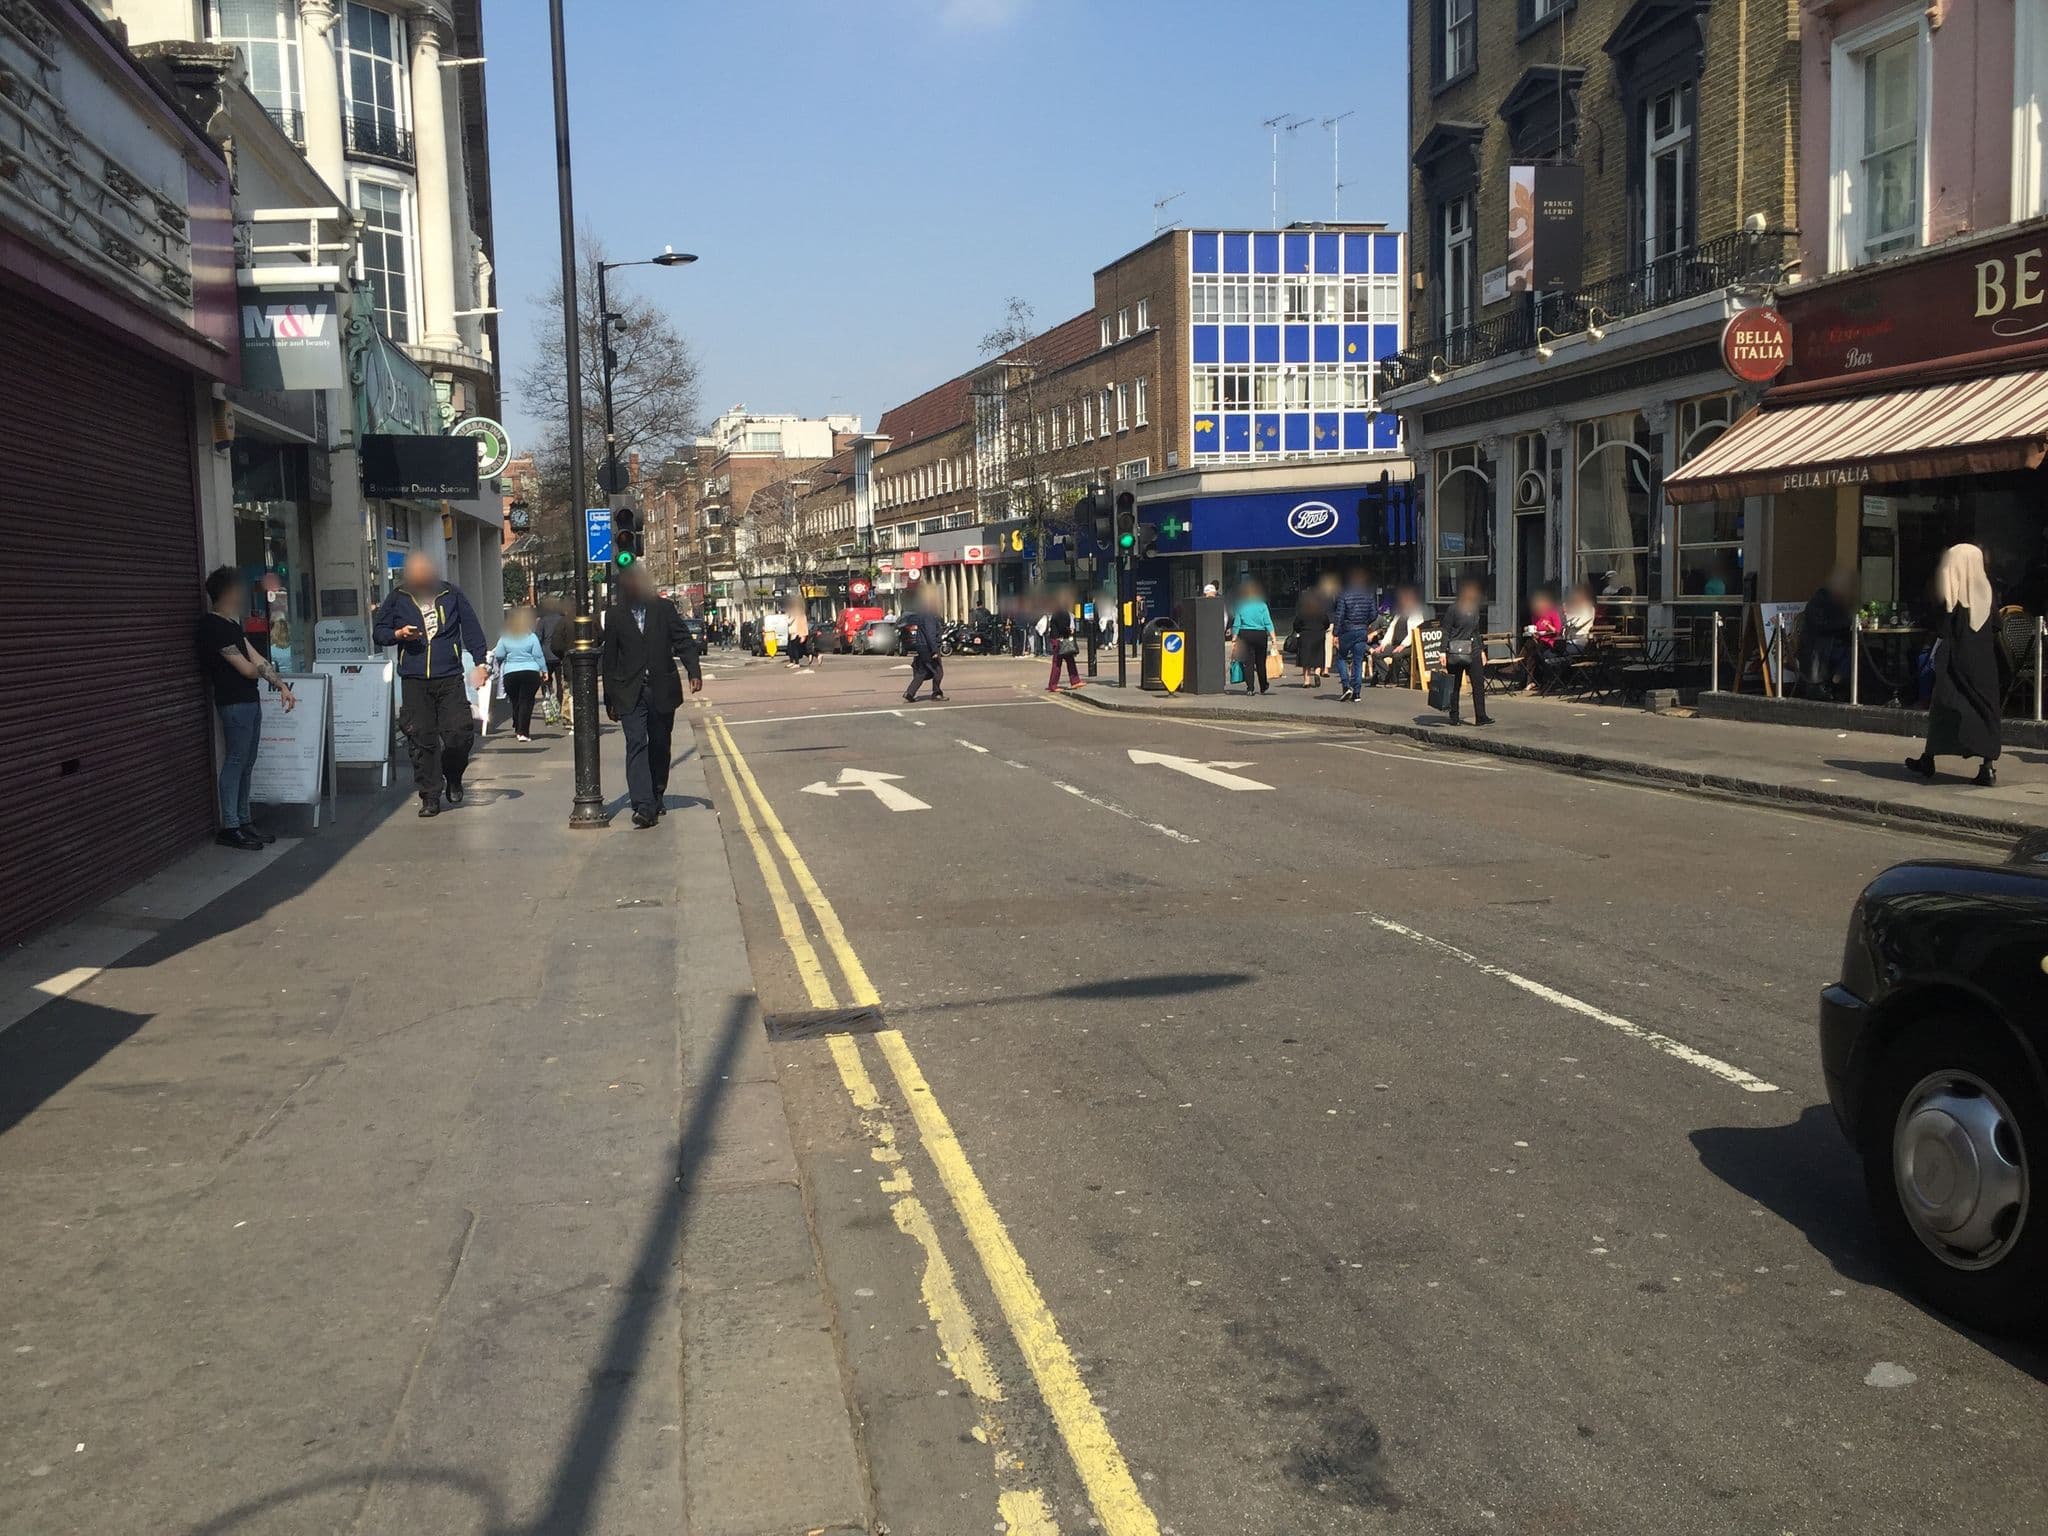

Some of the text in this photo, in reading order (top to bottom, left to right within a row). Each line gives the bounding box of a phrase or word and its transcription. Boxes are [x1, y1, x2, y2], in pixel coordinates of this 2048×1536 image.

[1974, 247, 2045, 317] BE
[242, 304, 328, 338] M&V
[1736, 331, 1783, 344] BELLA
[1734, 346, 1784, 359] ITALIA
[1845, 348, 1873, 369] Bar
[1783, 466, 1870, 489] BELLA ITALIA
[1294, 509, 1328, 529] Boots
[1421, 630, 1443, 641] FOOD
